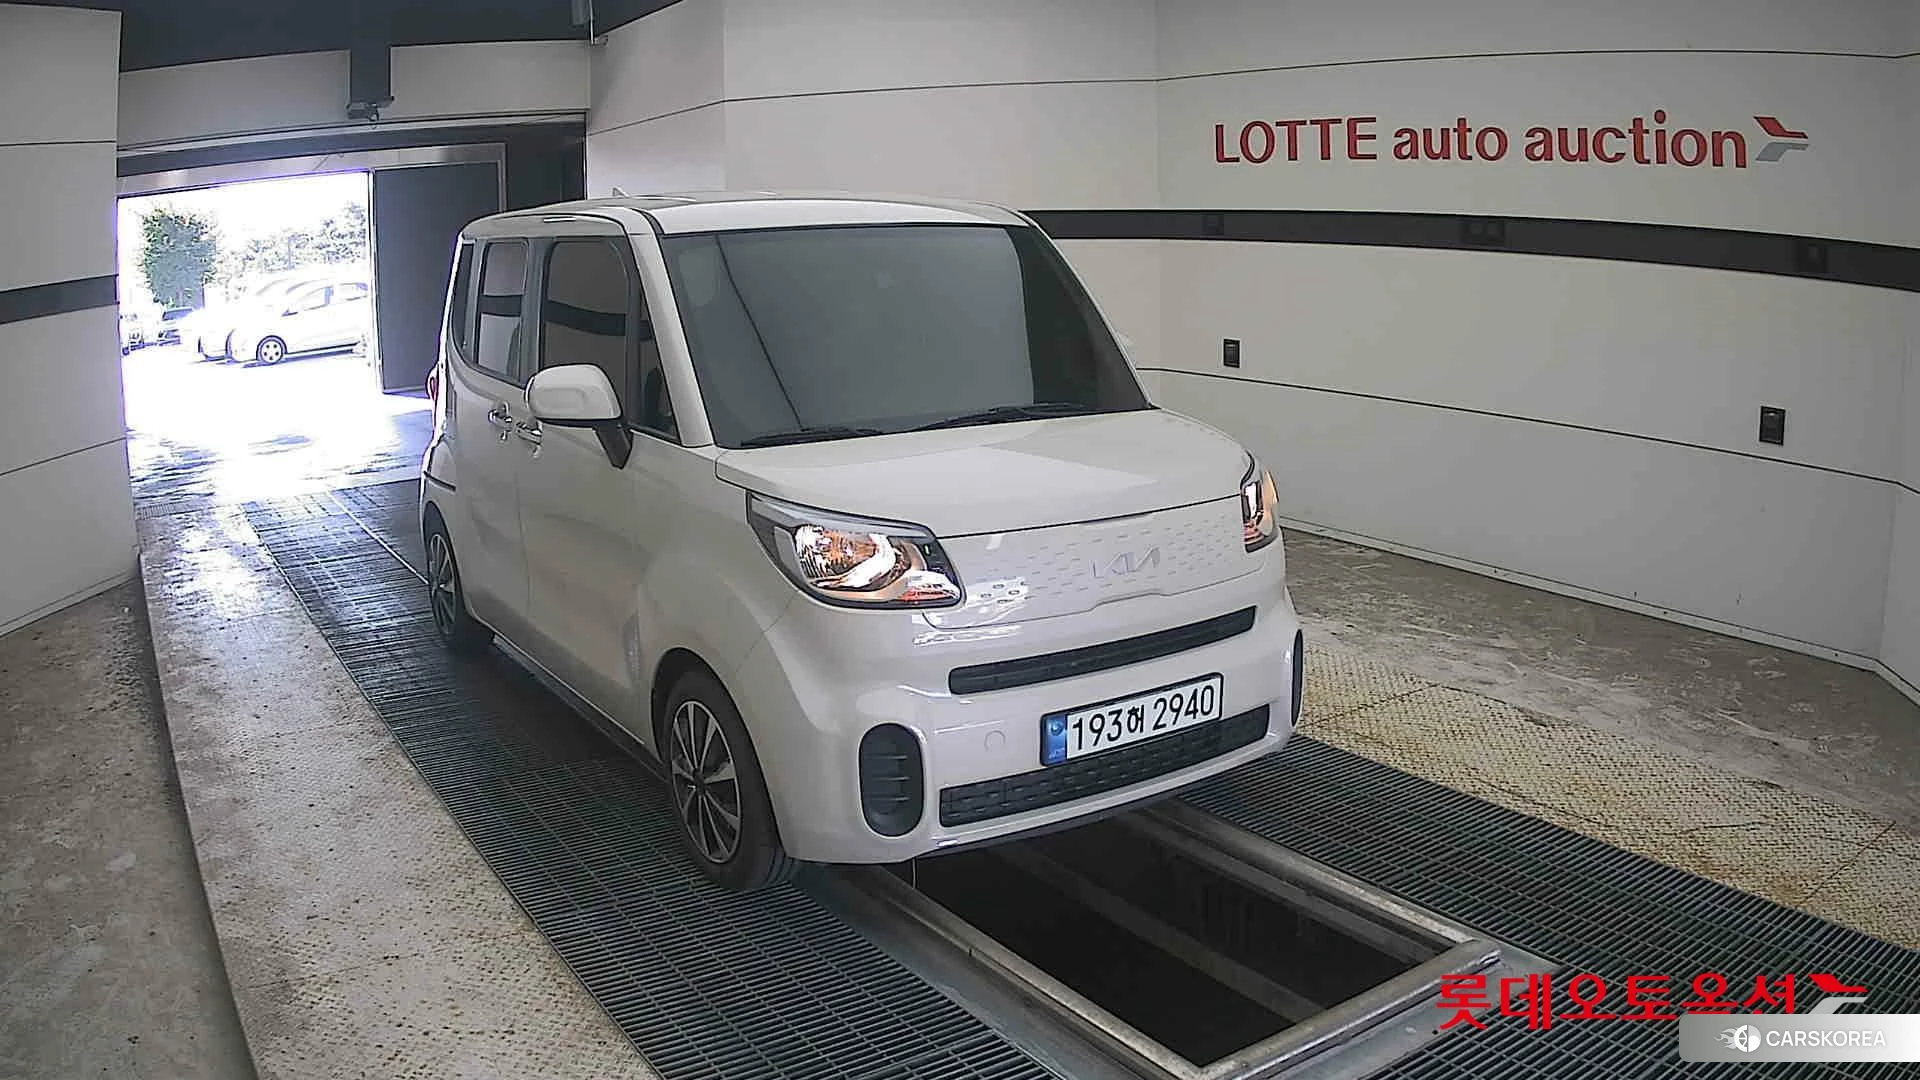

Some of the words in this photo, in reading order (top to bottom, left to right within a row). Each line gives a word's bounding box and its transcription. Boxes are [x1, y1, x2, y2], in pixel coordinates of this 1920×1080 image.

[1214, 116, 1378, 163] LOTTE
[1392, 117, 1509, 161] auto
[1524, 110, 1748, 168] auction
[1072, 704, 1145, 751] 193허
[1152, 684, 1216, 731] 2940
